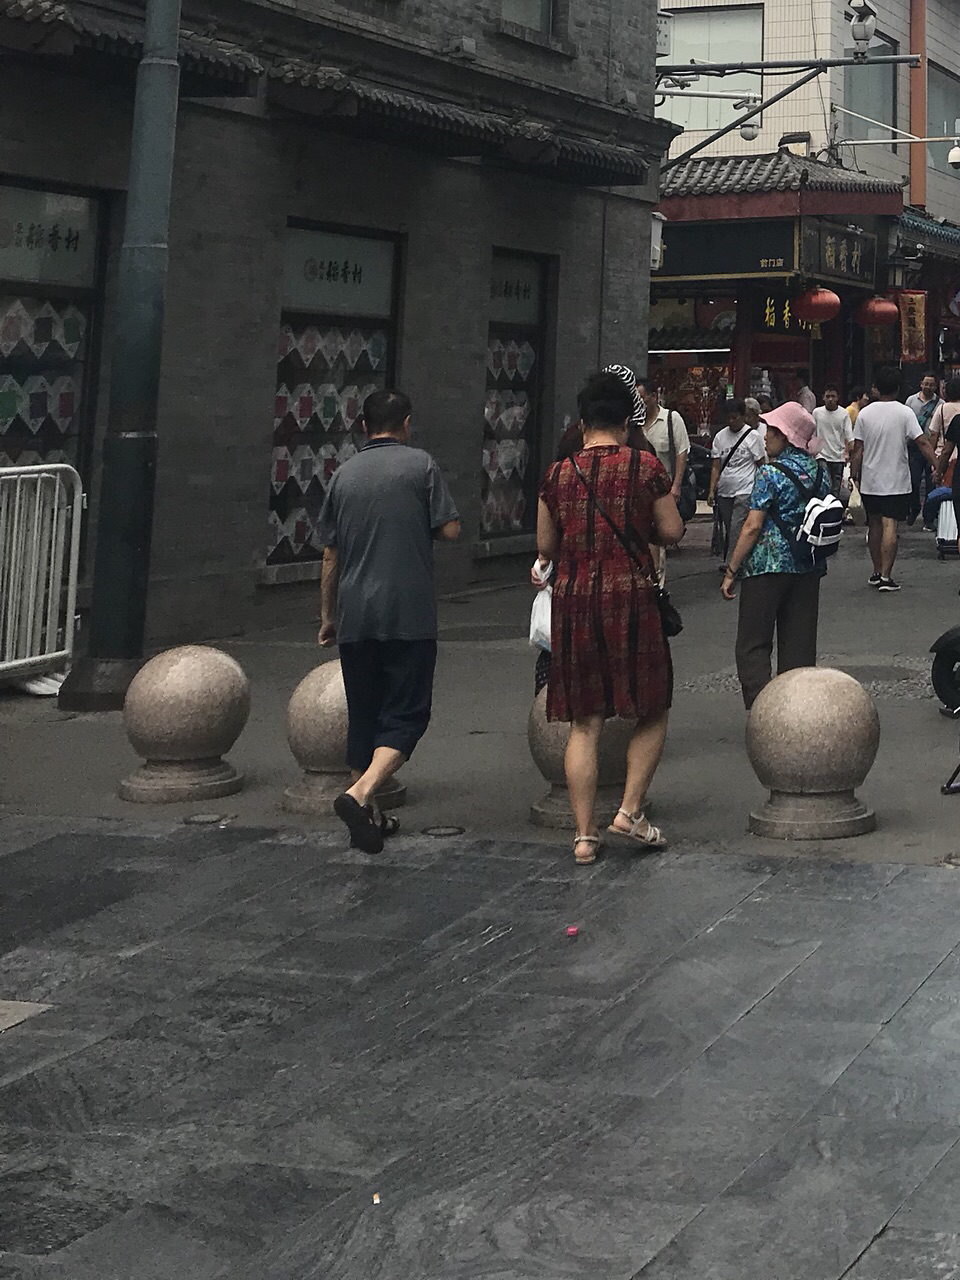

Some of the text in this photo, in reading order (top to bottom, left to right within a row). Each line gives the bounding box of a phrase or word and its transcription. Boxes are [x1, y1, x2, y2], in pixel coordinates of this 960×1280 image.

[759, 257, 784, 268] 前门店
[764, 296, 812, 330] 稻香
